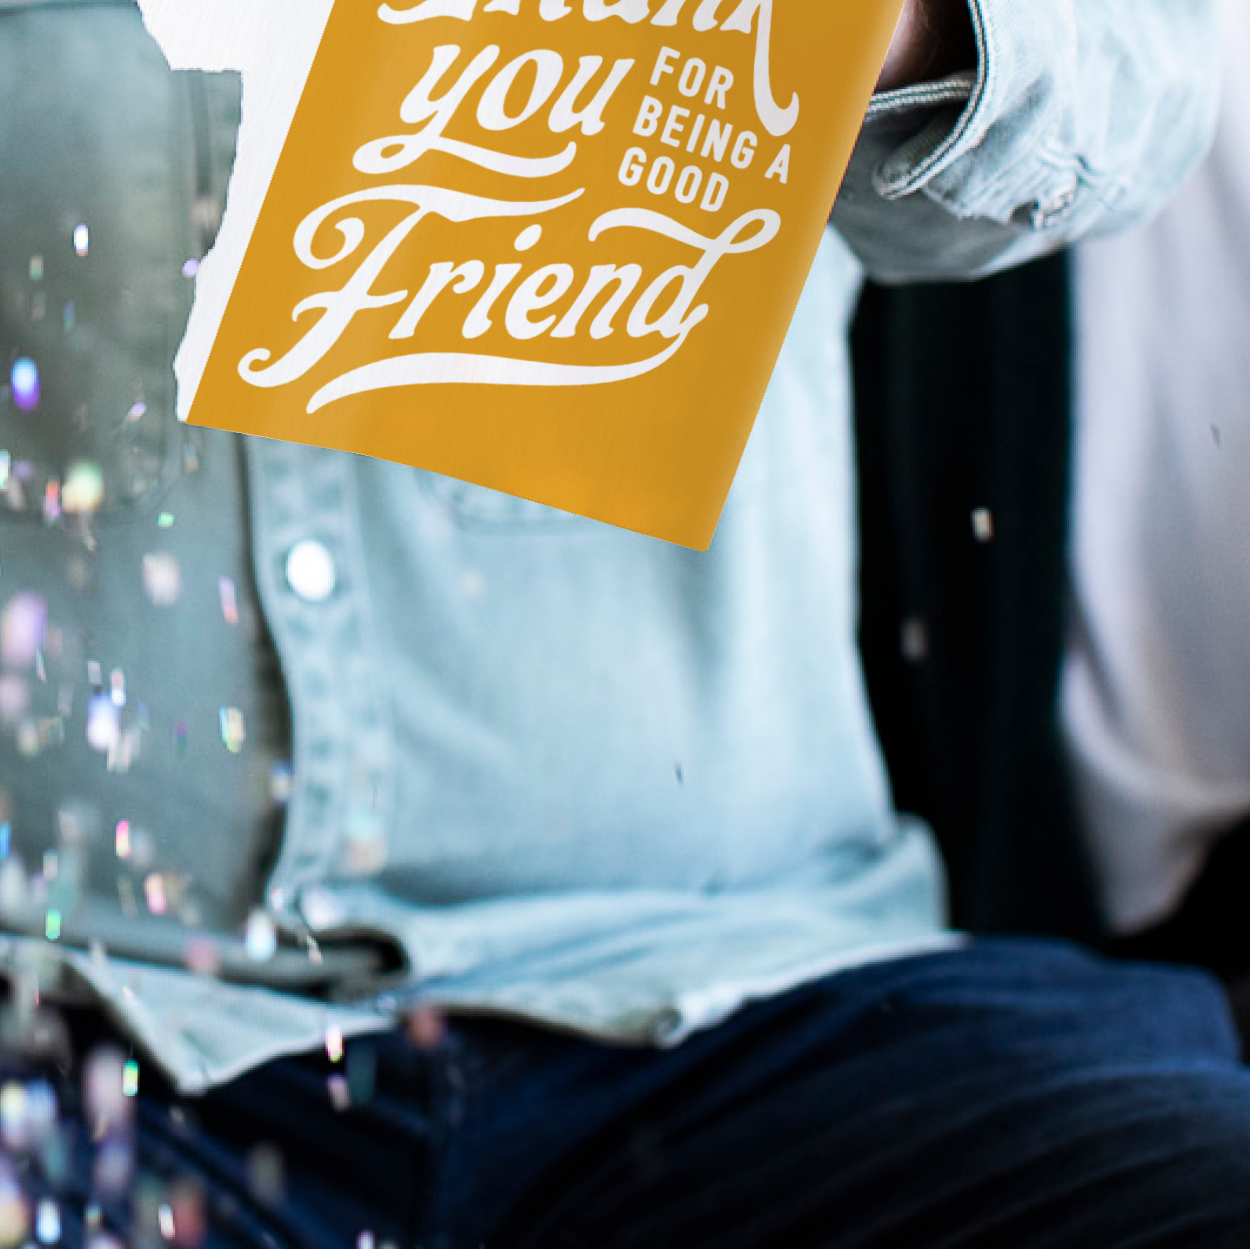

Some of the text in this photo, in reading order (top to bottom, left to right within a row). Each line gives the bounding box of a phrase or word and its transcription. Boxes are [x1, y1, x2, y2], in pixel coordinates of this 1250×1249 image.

[352, 44, 636, 178] you
[649, 46, 735, 110] FOR
[618, 146, 730, 213] GOOD
[632, 95, 792, 184] BEING A
[237, 184, 781, 415] Friend
